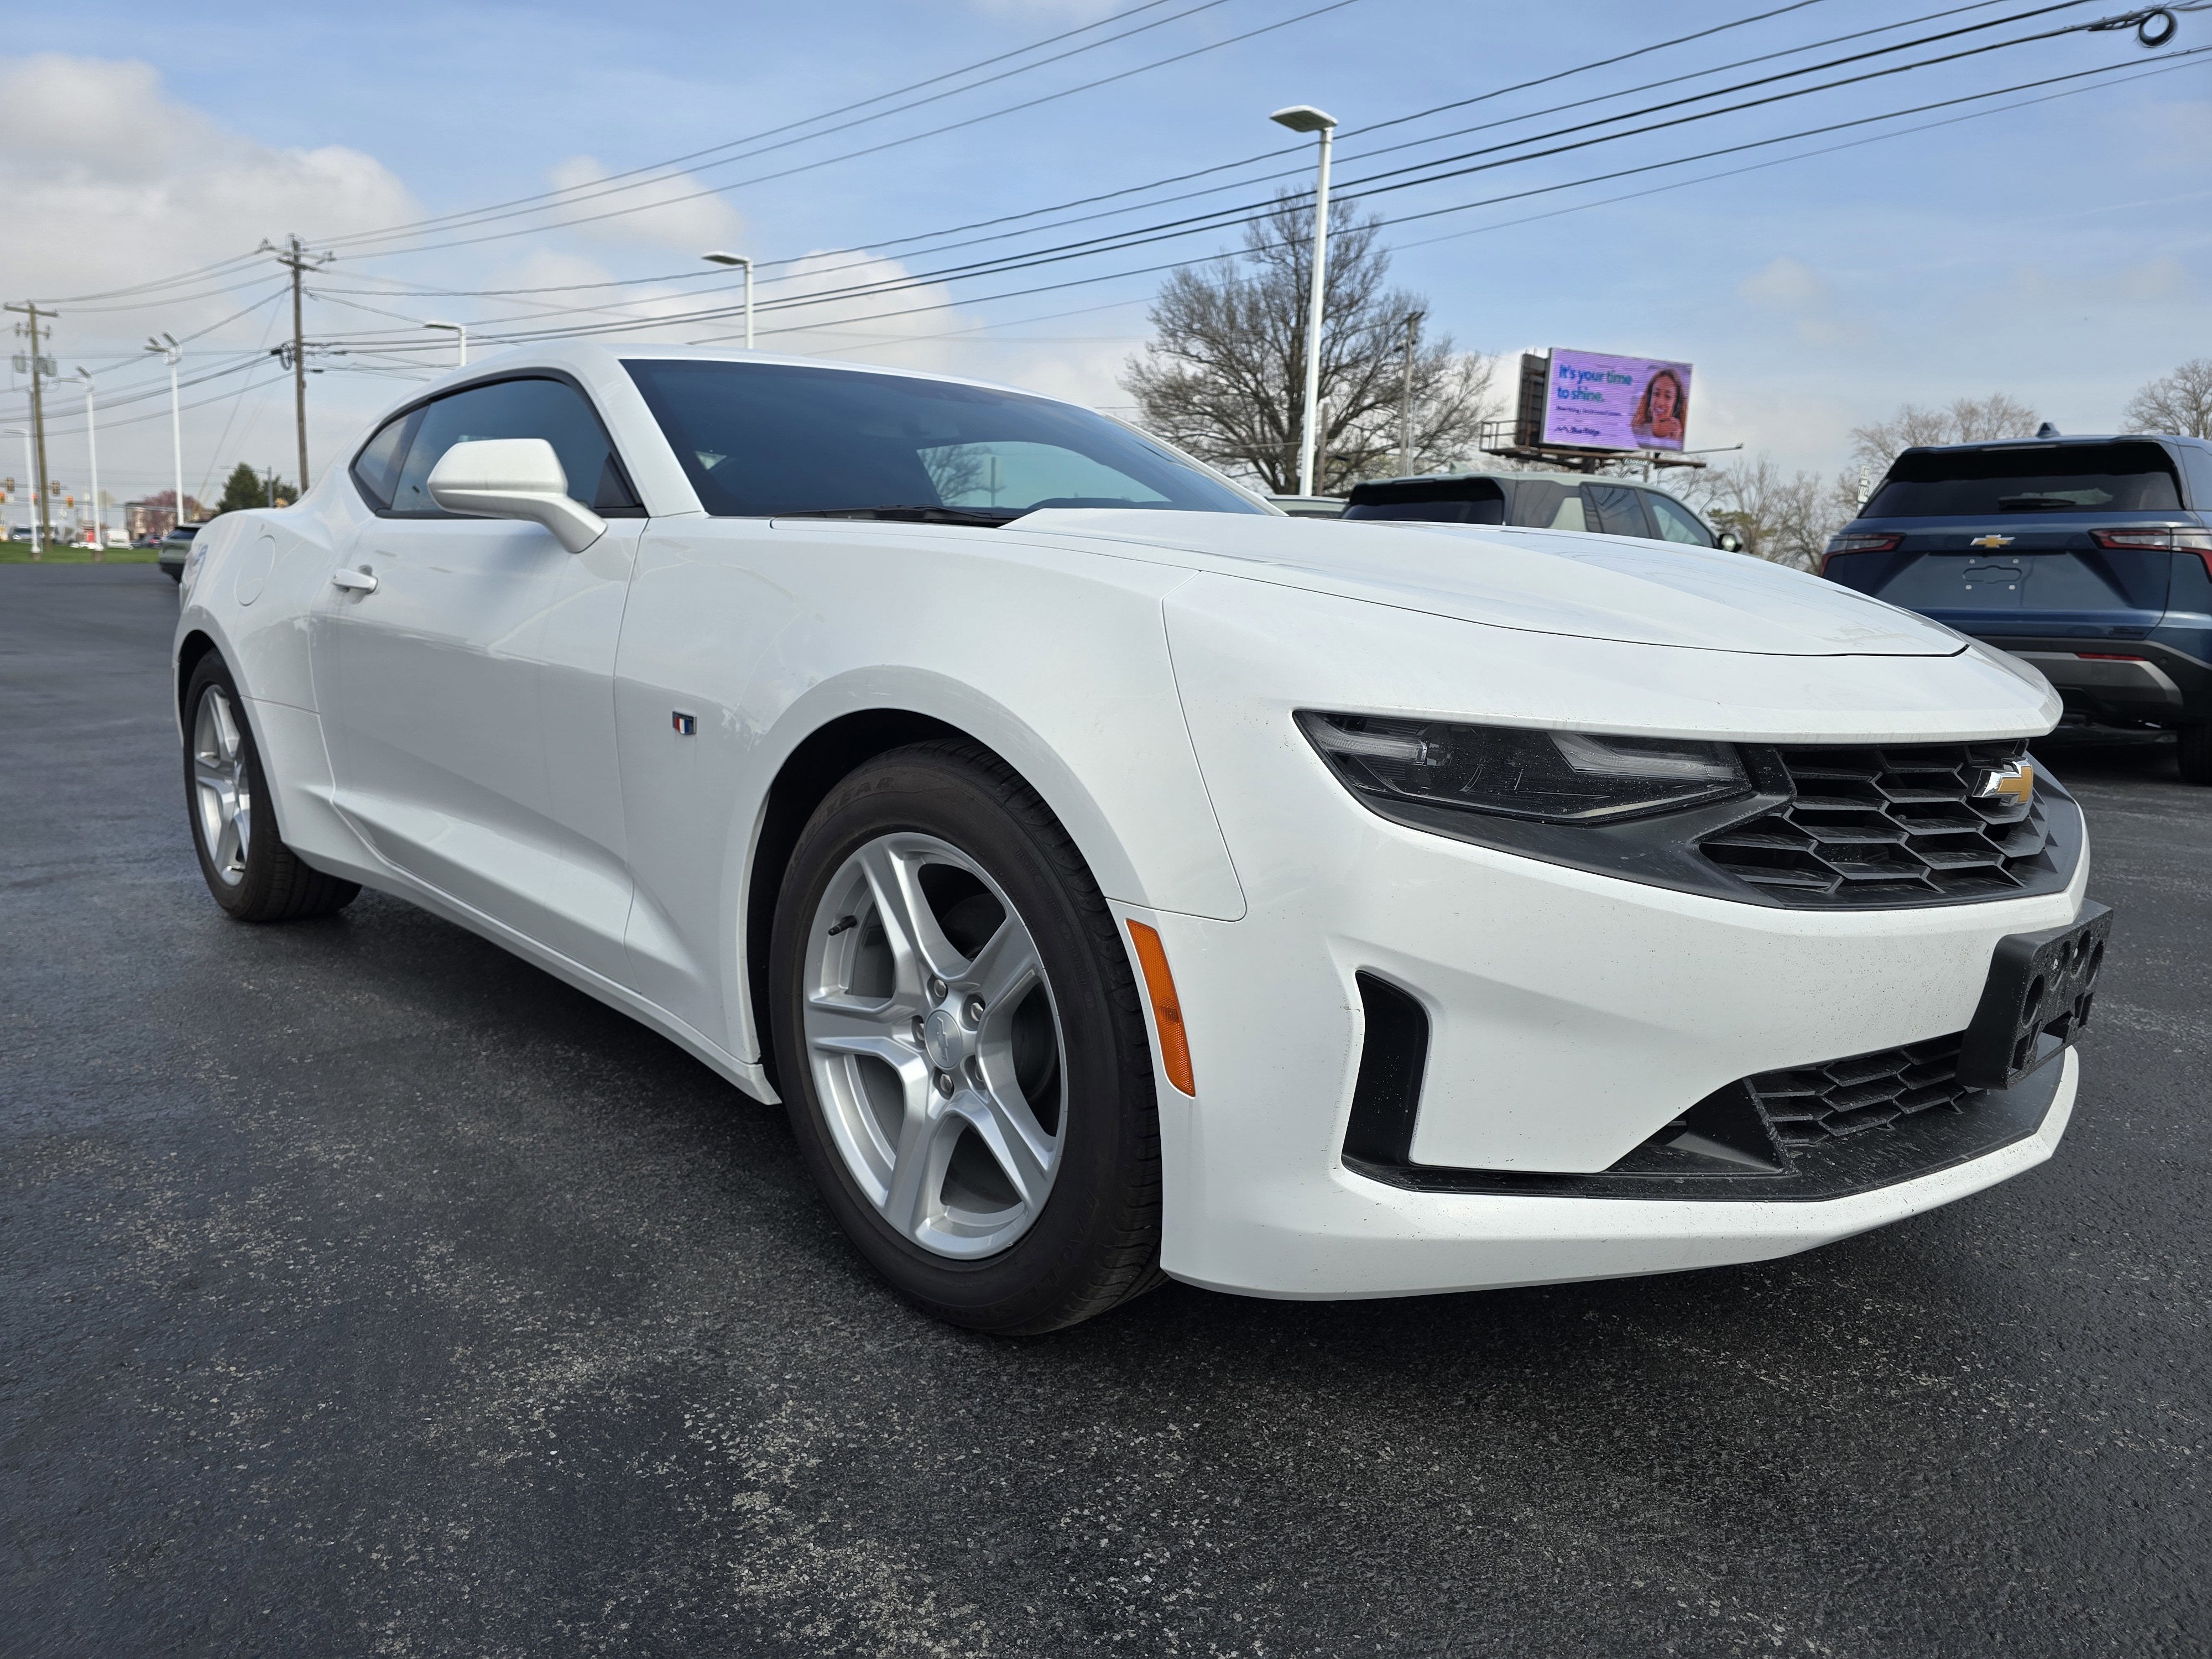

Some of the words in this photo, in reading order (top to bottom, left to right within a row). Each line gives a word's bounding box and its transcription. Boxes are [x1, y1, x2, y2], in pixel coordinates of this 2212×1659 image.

[1560, 364, 1575, 379] It's
[1578, 370, 1604, 384] your
[1606, 370, 1632, 384] time
[1557, 387, 1569, 399] to
[1571, 387, 1604, 403] shine.
